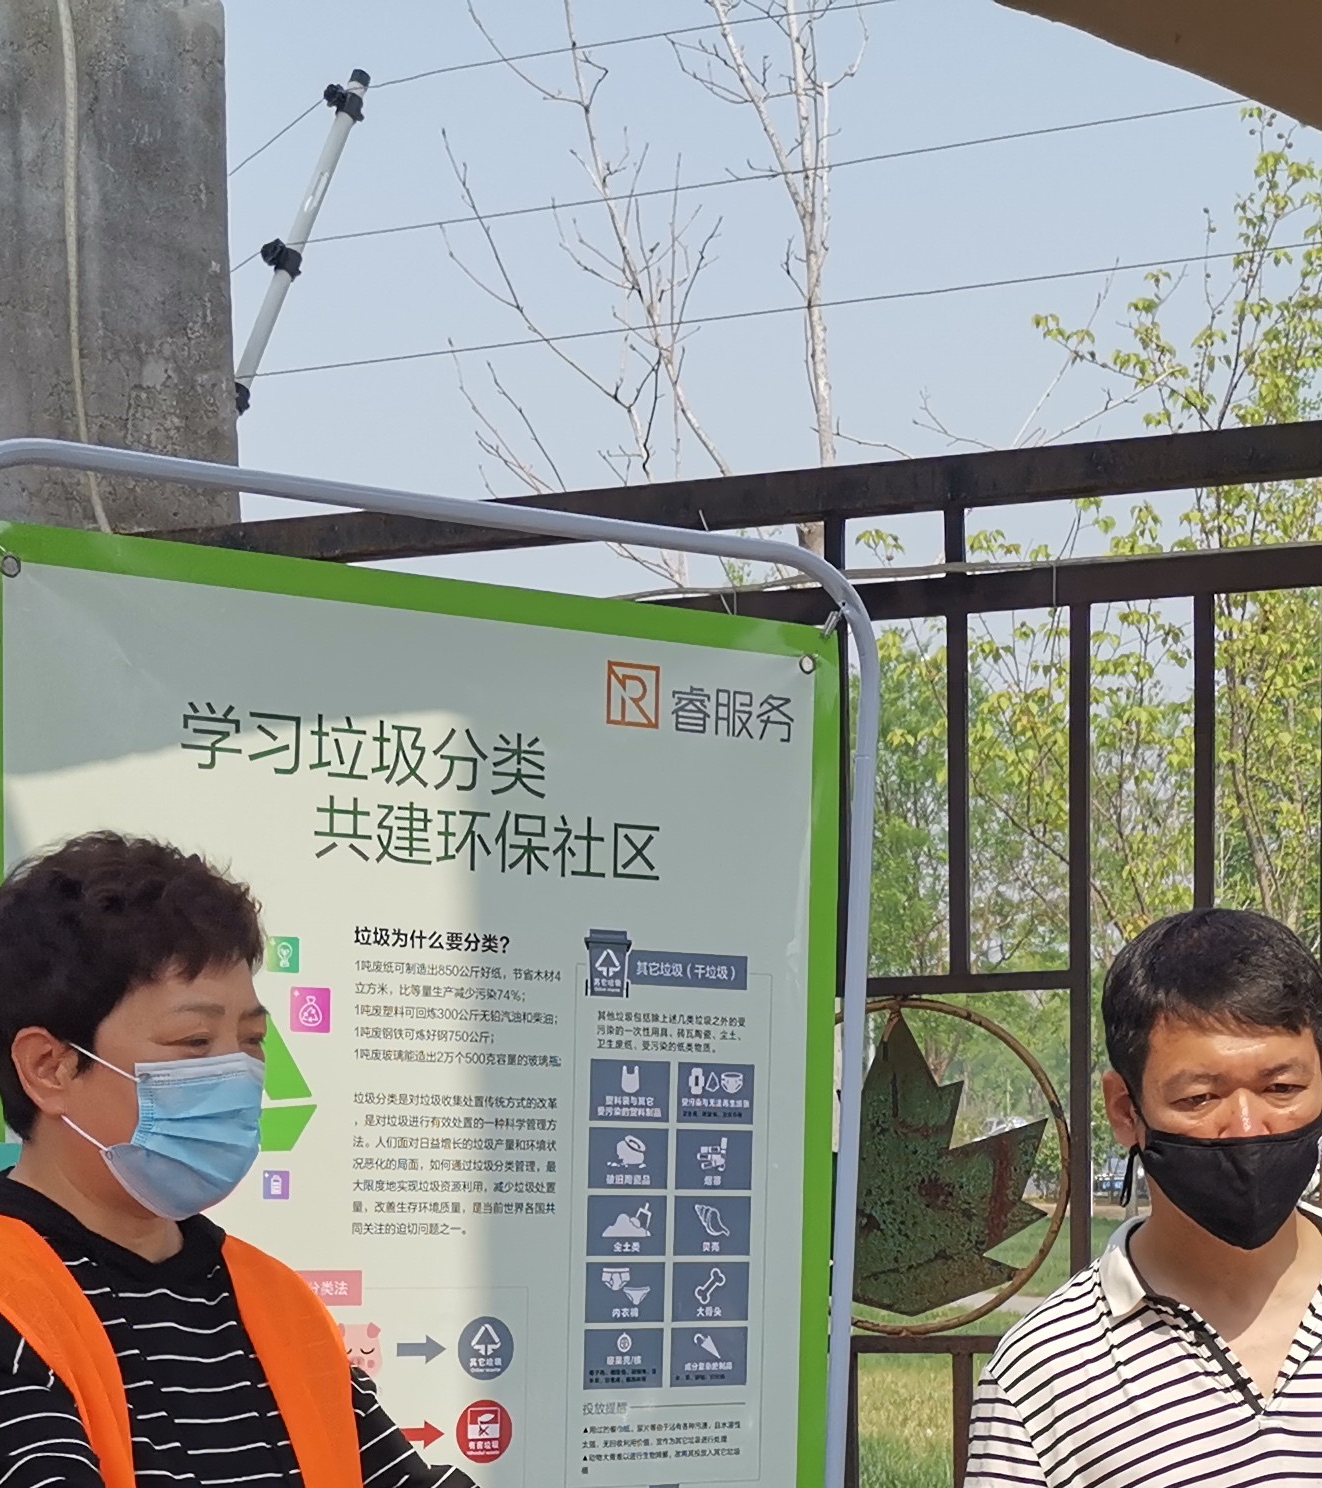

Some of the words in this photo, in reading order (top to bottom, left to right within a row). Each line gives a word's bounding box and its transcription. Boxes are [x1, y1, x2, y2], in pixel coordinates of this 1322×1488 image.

[671, 686, 794, 742] 睿服务
[180, 701, 548, 798] 学习垃圾分类
[315, 796, 660, 881] 共建环保社区
[354, 926, 510, 954] 垃圾为什么要分类?
[354, 1092, 557, 1109] 垃圾分类是对垃圾收集处置传统方式的改革
